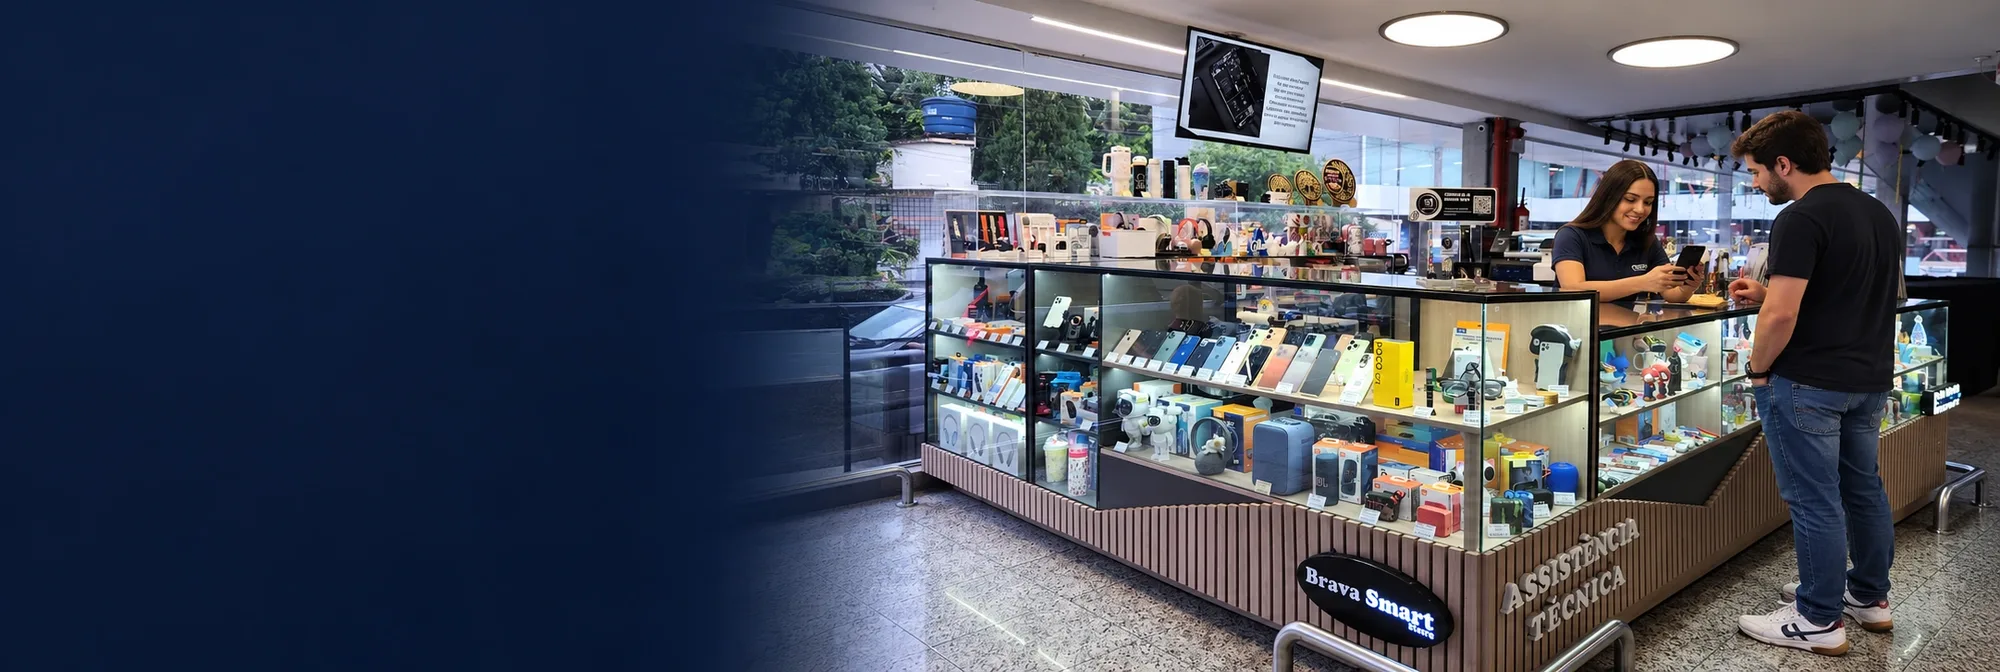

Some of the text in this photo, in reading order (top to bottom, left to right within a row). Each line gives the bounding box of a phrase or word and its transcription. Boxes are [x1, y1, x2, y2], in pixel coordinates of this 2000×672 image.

[1375, 341, 1383, 371] POCO
[1305, 566, 1435, 631] Brava Smart
[1500, 517, 1640, 614] ASSISTÊNCIA
[1525, 565, 1626, 641] TÉCNICA
